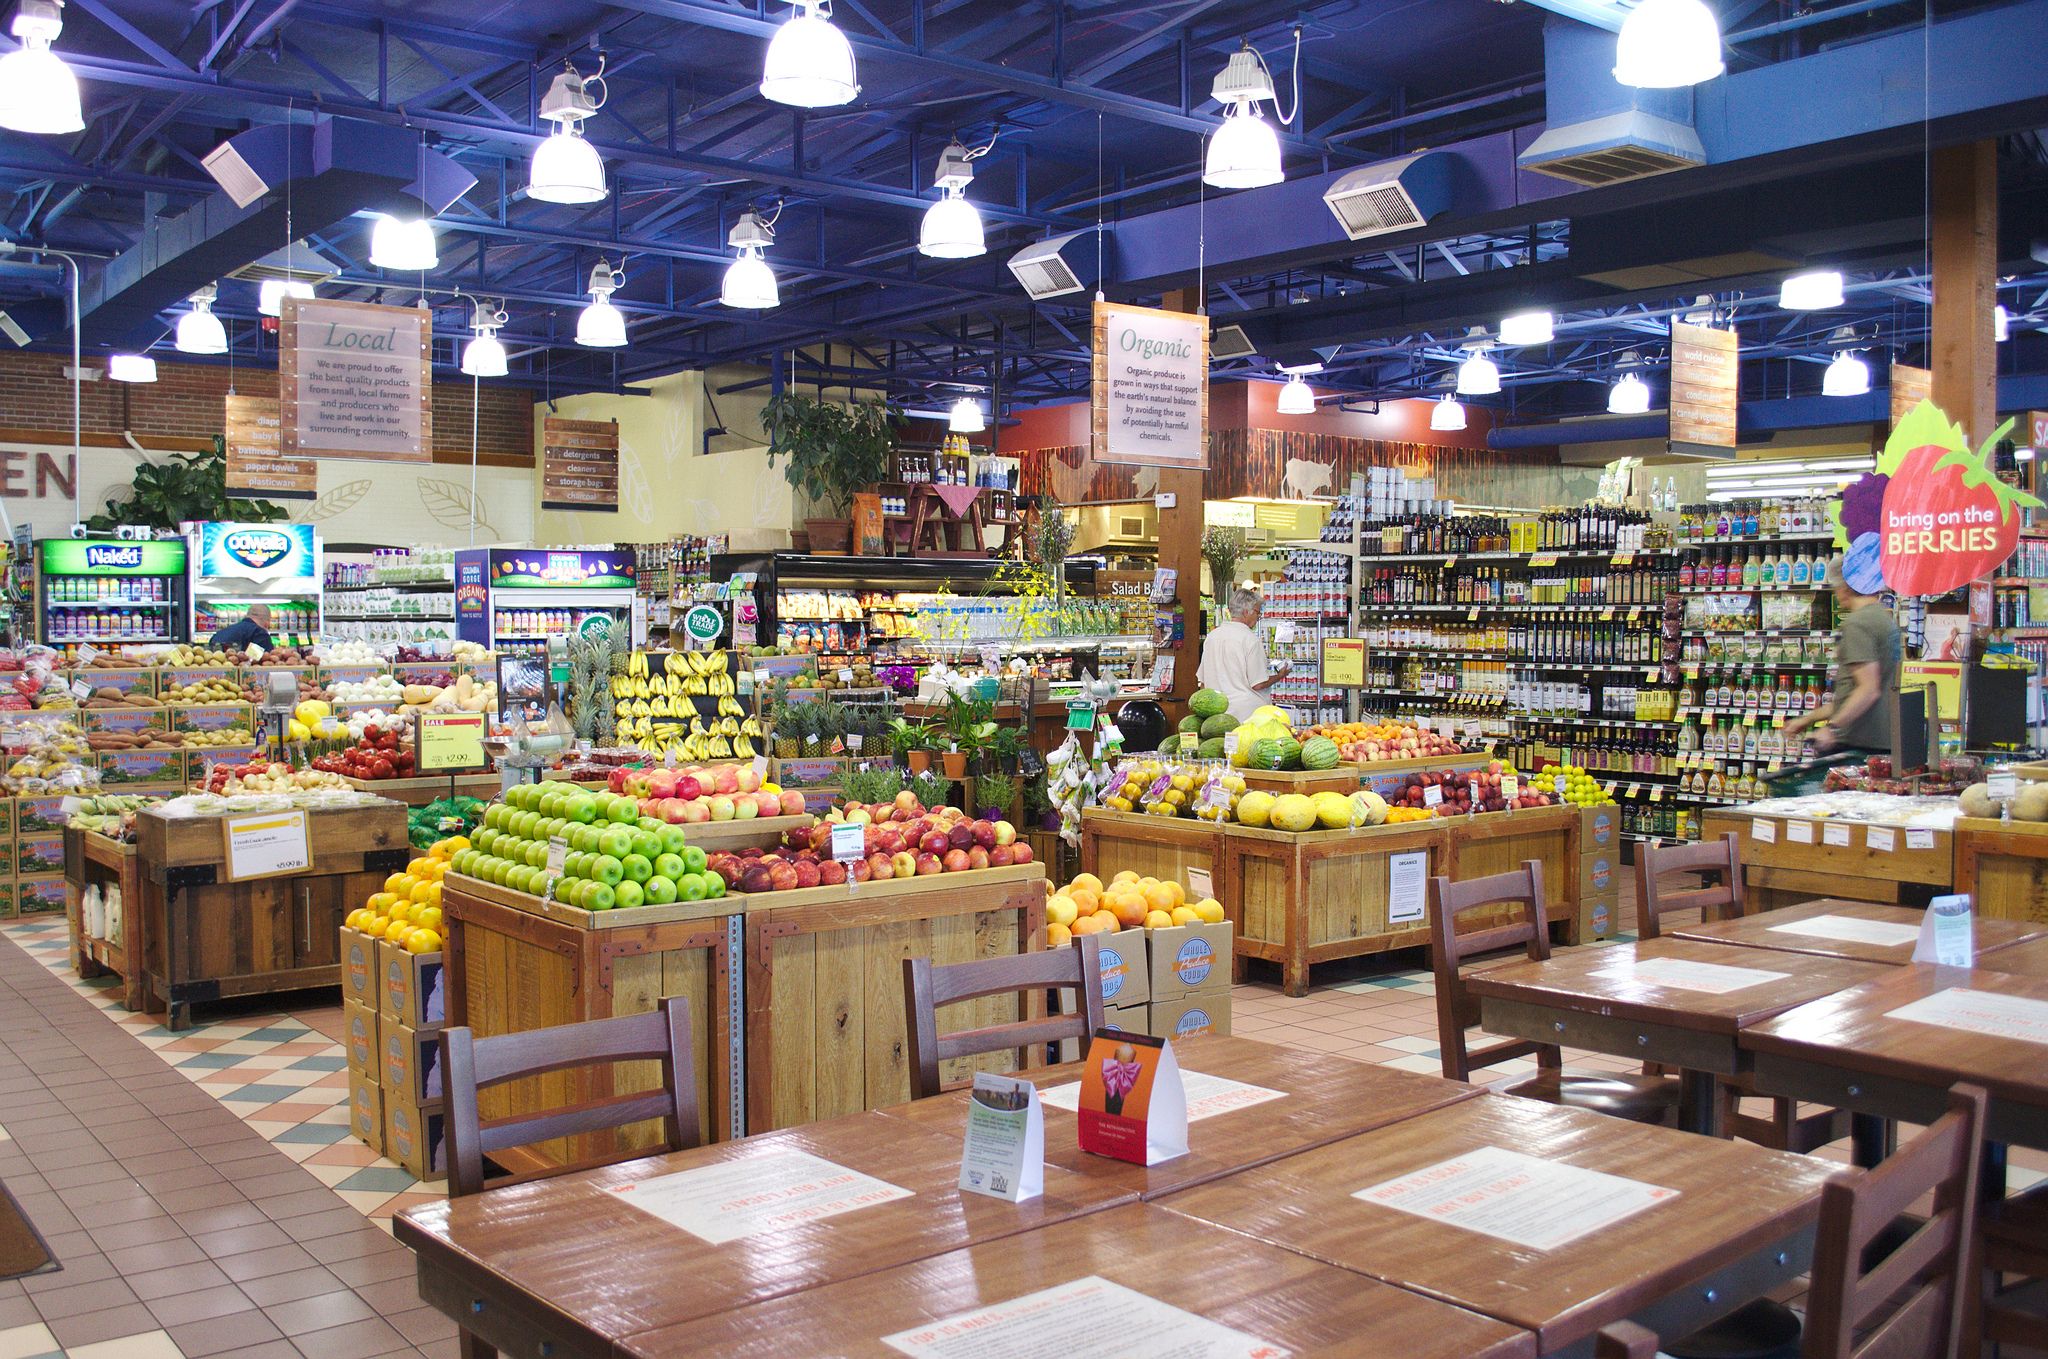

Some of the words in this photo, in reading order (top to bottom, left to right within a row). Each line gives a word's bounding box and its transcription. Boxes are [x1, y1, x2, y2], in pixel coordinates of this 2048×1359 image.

[324, 322, 396, 351] Local
[1120, 328, 1192, 360] Organic
[317, 360, 329, 368] We
[348, 363, 372, 372] proud
[384, 365, 403, 374] offer
[1126, 366, 1152, 378] Organic
[1154, 370, 1180, 380] produce
[1180, 372, 1186, 380] is
[310, 372, 323, 381] the
[326, 373, 342, 382] best
[346, 376, 372, 387] quality
[374, 378, 410, 387] products
[309, 384, 330, 394] from
[332, 387, 356, 397] small,
[358, 388, 378, 398] local
[380, 390, 410, 400] farmers
[1114, 379, 1134, 388] grown
[1136, 379, 1142, 388] in
[1144, 382, 1160, 390] ways
[1160, 382, 1173, 390] that
[1174, 384, 1198, 394] support
[1114, 391, 1126, 399] the
[1126, 392, 1149, 402] earth's
[1150, 394, 1172, 403] natural
[1173, 394, 1197, 406] balance
[321, 400, 336, 408] and
[339, 402, 380, 412] producers
[382, 404, 400, 412] who
[1126, 404, 1134, 414] by
[1135, 406, 1162, 417] avoiding
[1163, 407, 1174, 416] the
[1175, 409, 1186, 418] use
[258, 416, 280, 428] diape
[320, 412, 334, 420] live
[336, 413, 352, 422] and
[354, 414, 374, 423] work
[1122, 418, 1130, 426] of
[1130, 418, 1164, 429] potentially
[1164, 420, 1189, 430] harmful
[310, 425, 360, 437] surrounding
[362, 427, 410, 439] community.
[1140, 431, 1173, 442] chemicals.
[238, 446, 279, 456] bathroom
[563, 450, 600, 460] detergents
[246, 462, 269, 471] paper
[272, 464, 298, 472] towels
[567, 464, 596, 473] cleaners
[248, 477, 295, 487] plasticware
[560, 478, 586, 488] storage
[587, 479, 604, 488] bags
[1888, 510, 1934, 530] bring
[1938, 512, 1960, 527] on
[1964, 507, 1994, 524] the
[1888, 526, 1997, 555] BERRIES
[463, 575, 480, 583] GORGE
[458, 584, 486, 602] ORGANIC
[1112, 581, 1140, 595] Salad
[692, 613, 716, 624] WHOLE
[692, 620, 715, 630] TRADE
[1183, 944, 1208, 955] WHOLE
[1101, 956, 1118, 968] OLE
[1179, 958, 1210, 971] Produce
[1100, 968, 1121, 980] oduce
[1184, 970, 1206, 980] FOODS
[1102, 980, 1119, 991] ODS
[1182, 1016, 1206, 1028] WHOLE
[1178, 1029, 1208, 1040] Produce
[786, 1183, 815, 1197] BUY
[720, 1190, 780, 1212] LOCAL?
[852, 1188, 894, 1205] WHAT
